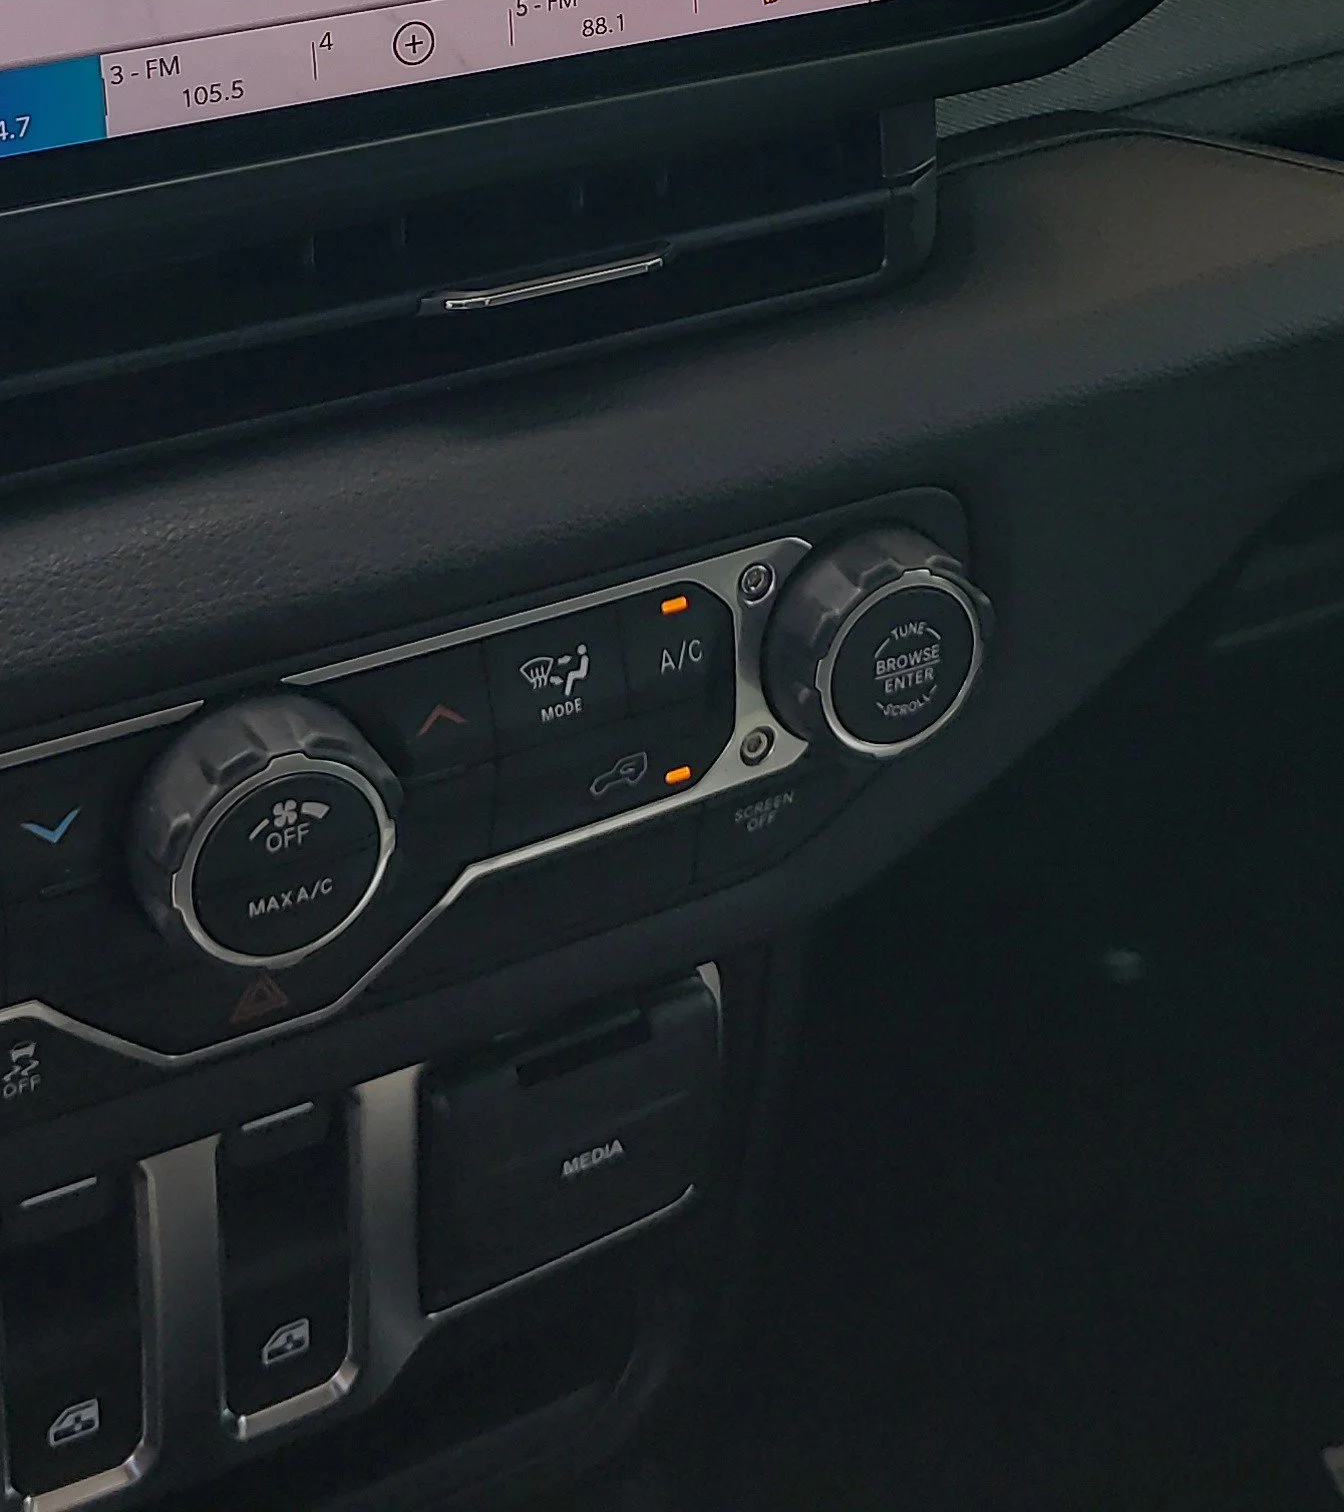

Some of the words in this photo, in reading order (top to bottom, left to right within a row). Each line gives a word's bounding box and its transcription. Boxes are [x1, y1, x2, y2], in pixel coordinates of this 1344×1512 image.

[581, 13, 626, 39] 88.1
[319, 31, 335, 54] 4
[110, 62, 124, 86] 3
[145, 55, 181, 80] FM
[182, 78, 245, 109] 105.5
[889, 620, 927, 642] TUNE
[659, 638, 704, 673] A/C
[874, 644, 941, 677] BROWSE
[883, 666, 935, 694] ENTER
[541, 697, 583, 723] MODE
[734, 790, 795, 824] SCREEN
[746, 810, 777, 833] OFF
[265, 824, 310, 852] OFF
[248, 889, 294, 918] MAX
[296, 876, 334, 904] A/C
[2, 1075, 42, 1098] OFF
[561, 1139, 624, 1178] MEDIA
